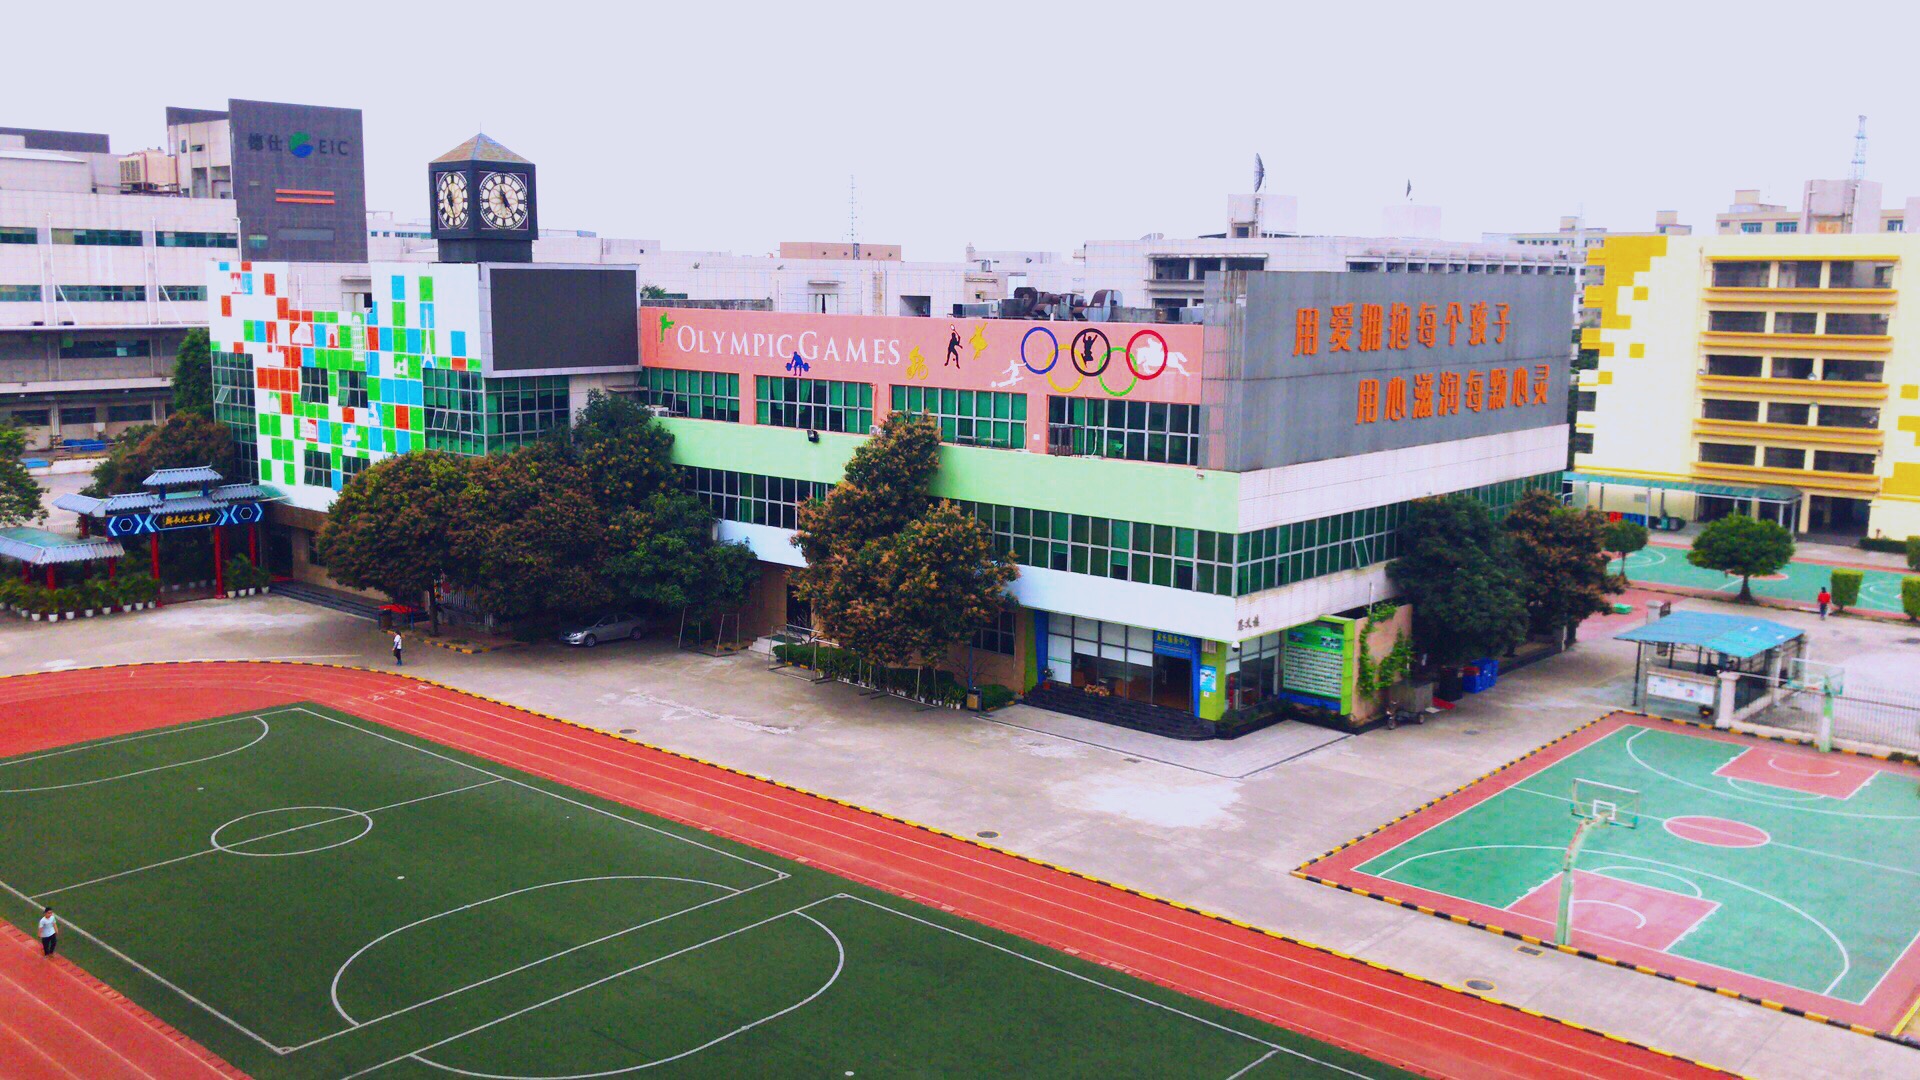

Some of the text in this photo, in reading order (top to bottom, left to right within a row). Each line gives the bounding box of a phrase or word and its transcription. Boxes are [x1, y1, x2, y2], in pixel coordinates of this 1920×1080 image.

[318, 139, 348, 156] EIC
[1293, 303, 1511, 356] 用爱拥抱每个孩子
[1356, 364, 1550, 425] 用心滋润每颗心灵
